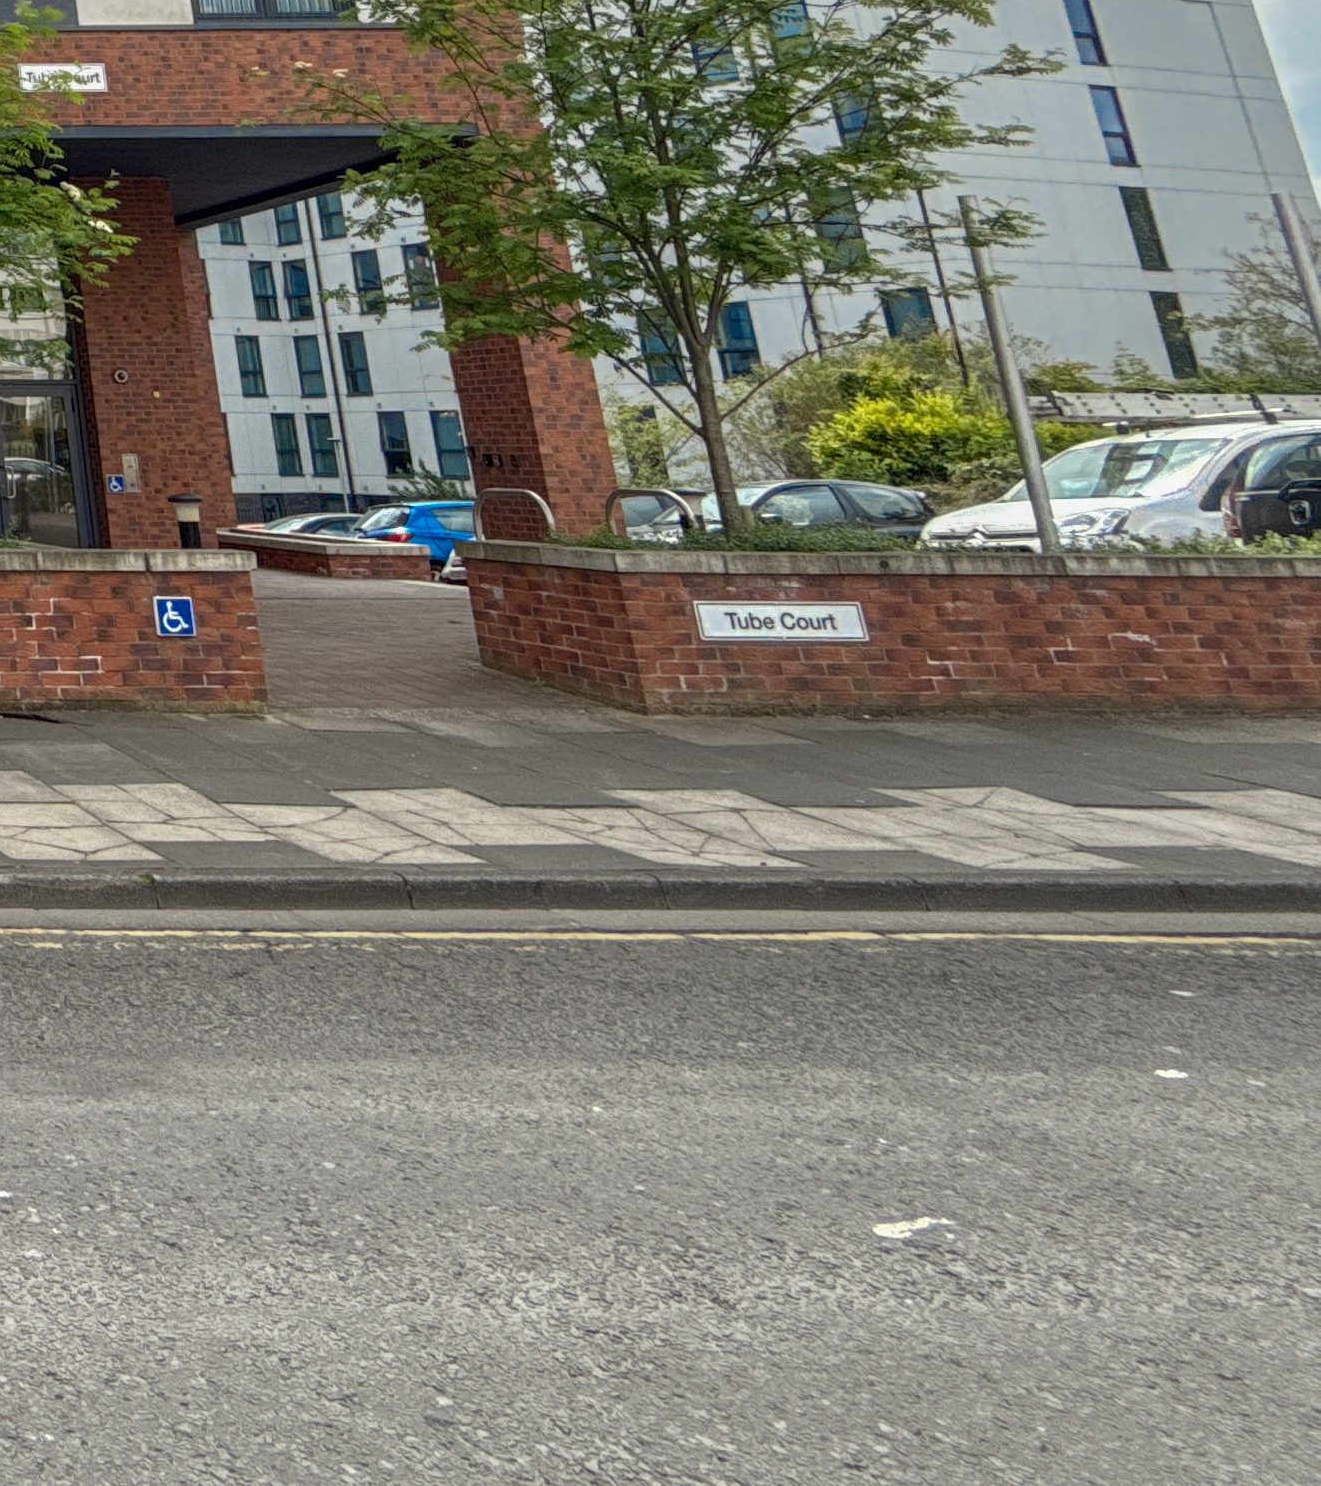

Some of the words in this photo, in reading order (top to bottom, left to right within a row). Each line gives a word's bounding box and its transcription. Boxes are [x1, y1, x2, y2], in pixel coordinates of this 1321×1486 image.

[24, 70, 56, 84] Tub
[63, 71, 102, 86] ourt
[723, 611, 775, 630] Tube
[779, 612, 838, 631] Court
